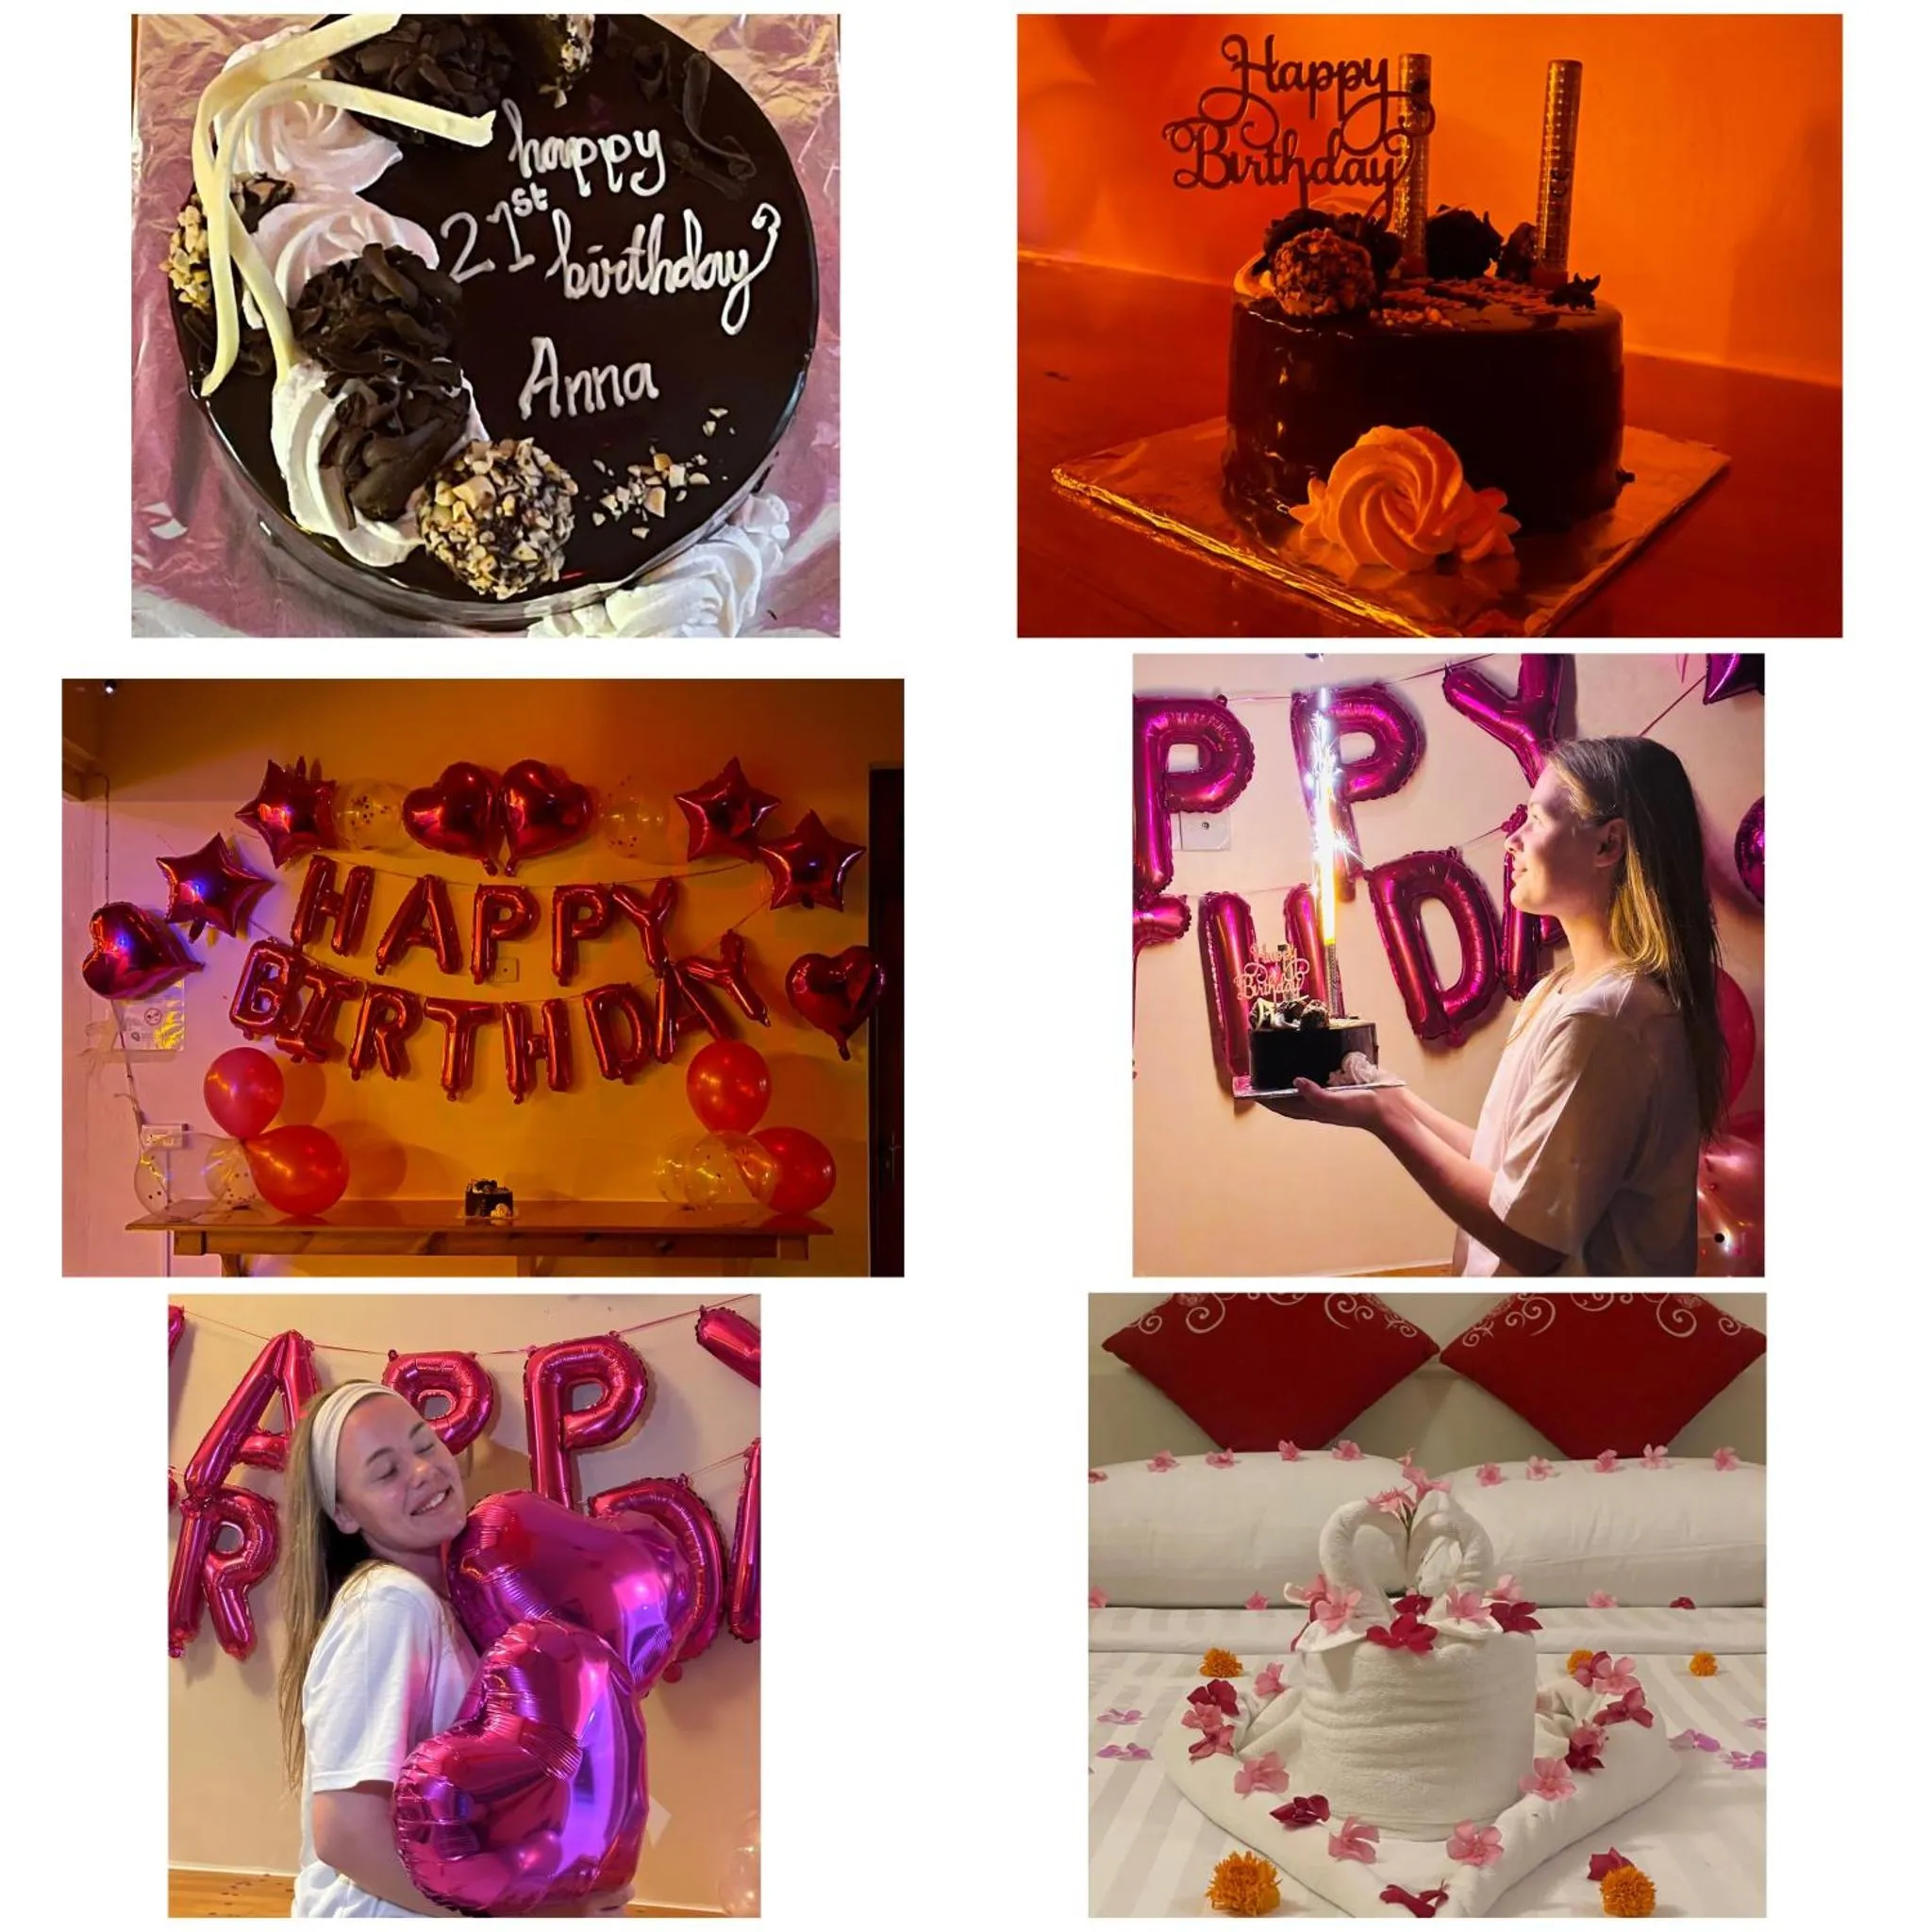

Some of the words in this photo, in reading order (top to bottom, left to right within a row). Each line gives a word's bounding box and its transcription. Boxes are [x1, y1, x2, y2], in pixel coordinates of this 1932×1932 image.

[501, 98, 666, 197] happy
[1199, 34, 1436, 155] Happy
[1162, 117, 1415, 228] Birthday
[440, 182, 550, 283] 21st
[544, 202, 782, 337] birthday
[518, 336, 659, 421] Anna
[291, 855, 679, 987] HAPPY
[228, 928, 772, 1104] BIRTHDAY
